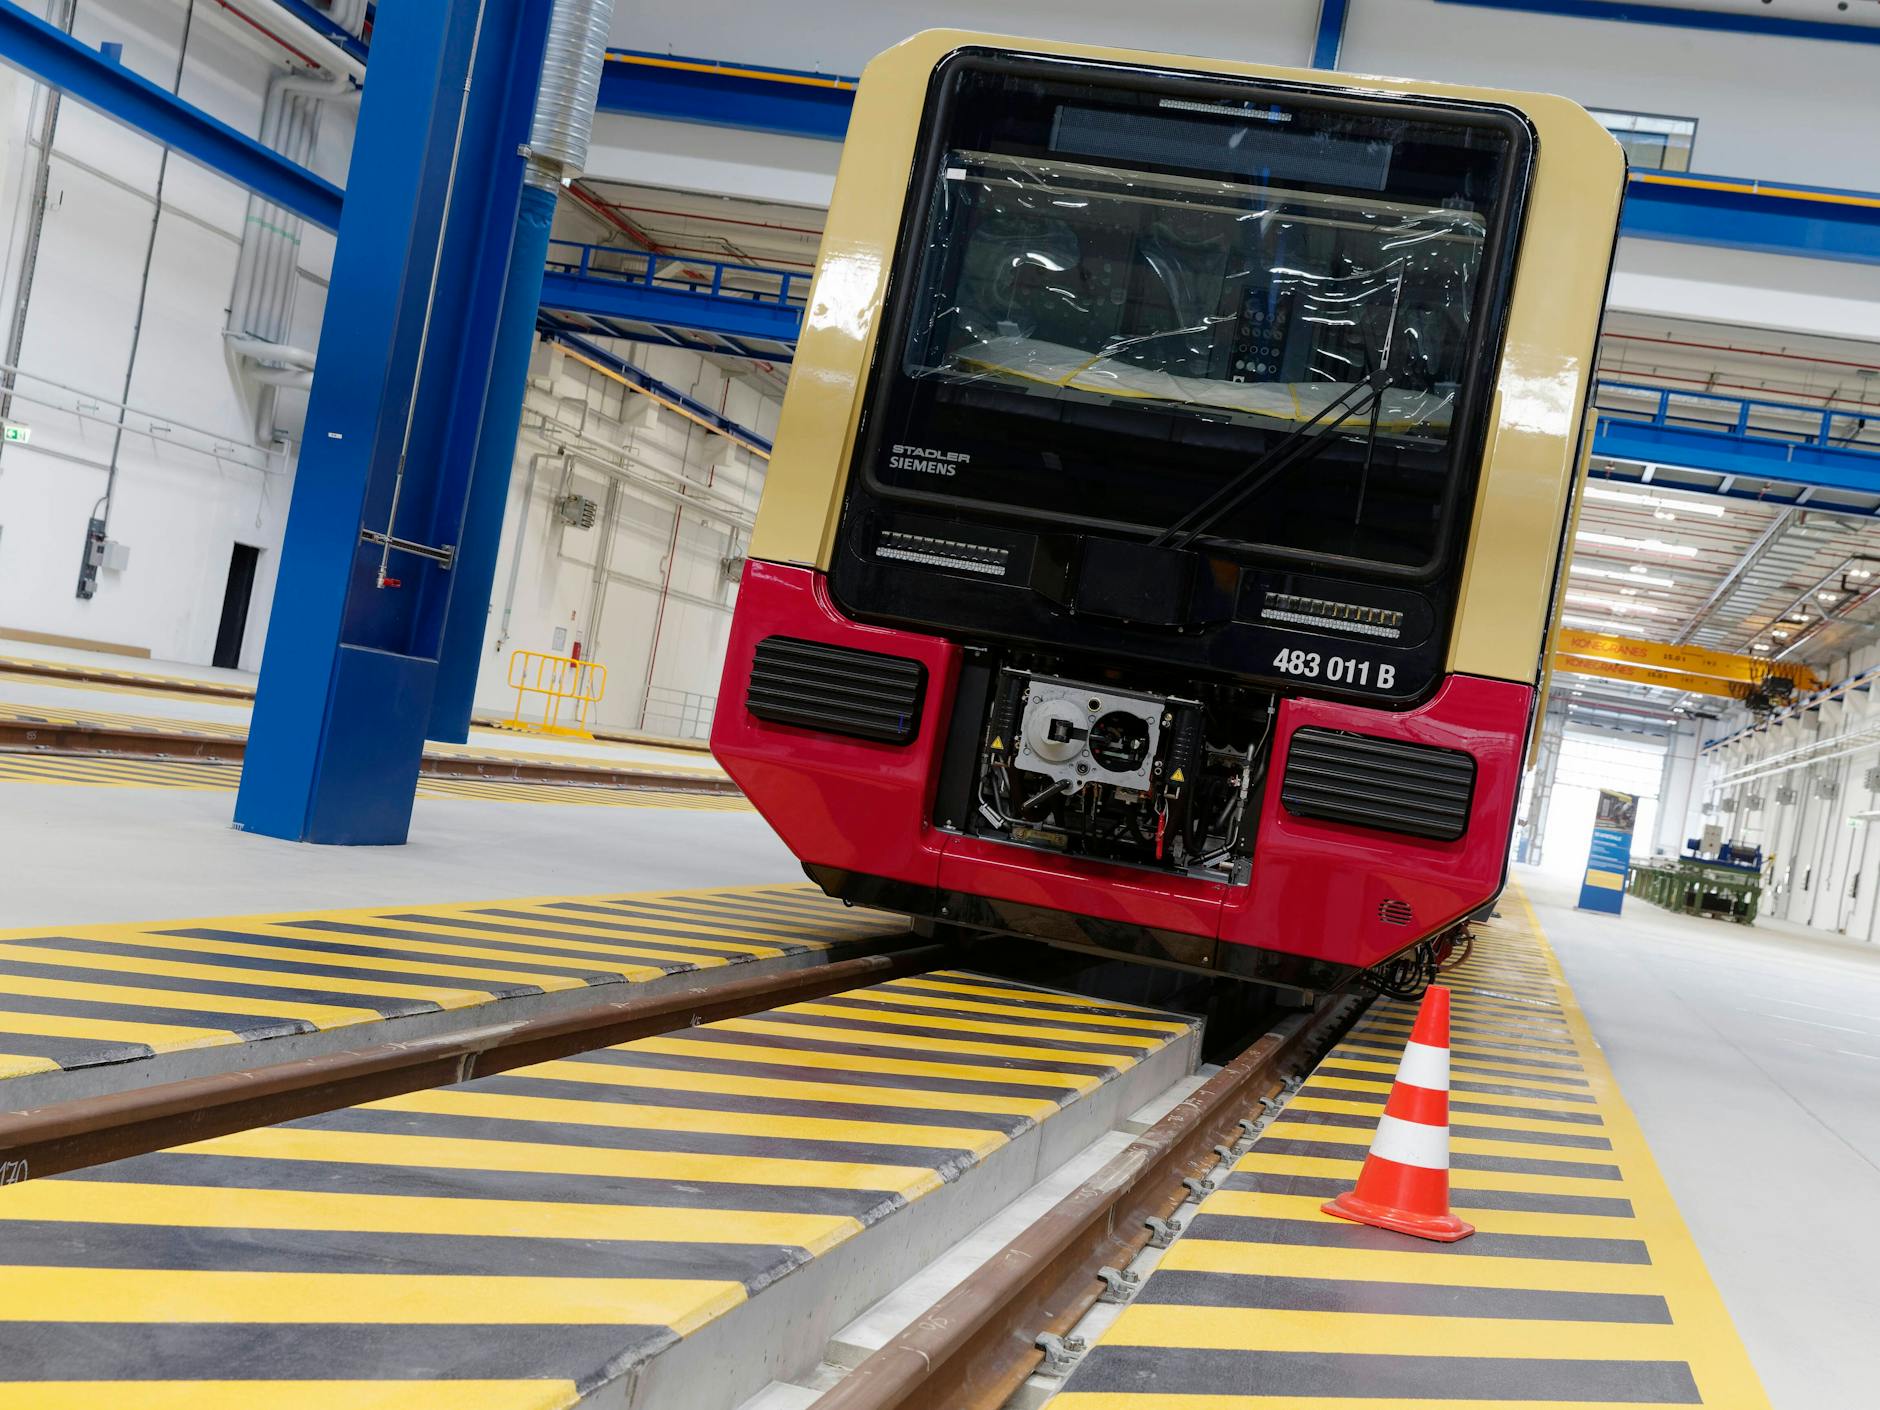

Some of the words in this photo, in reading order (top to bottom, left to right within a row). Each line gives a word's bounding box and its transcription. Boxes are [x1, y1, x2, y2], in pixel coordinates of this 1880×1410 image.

[892, 444, 970, 463] STADLER
[889, 456, 956, 476] SIEMENS
[1570, 637, 1648, 658] KONECRANES
[1273, 648, 1320, 677] 483
[1327, 656, 1370, 685] 011
[1377, 663, 1396, 689] B
